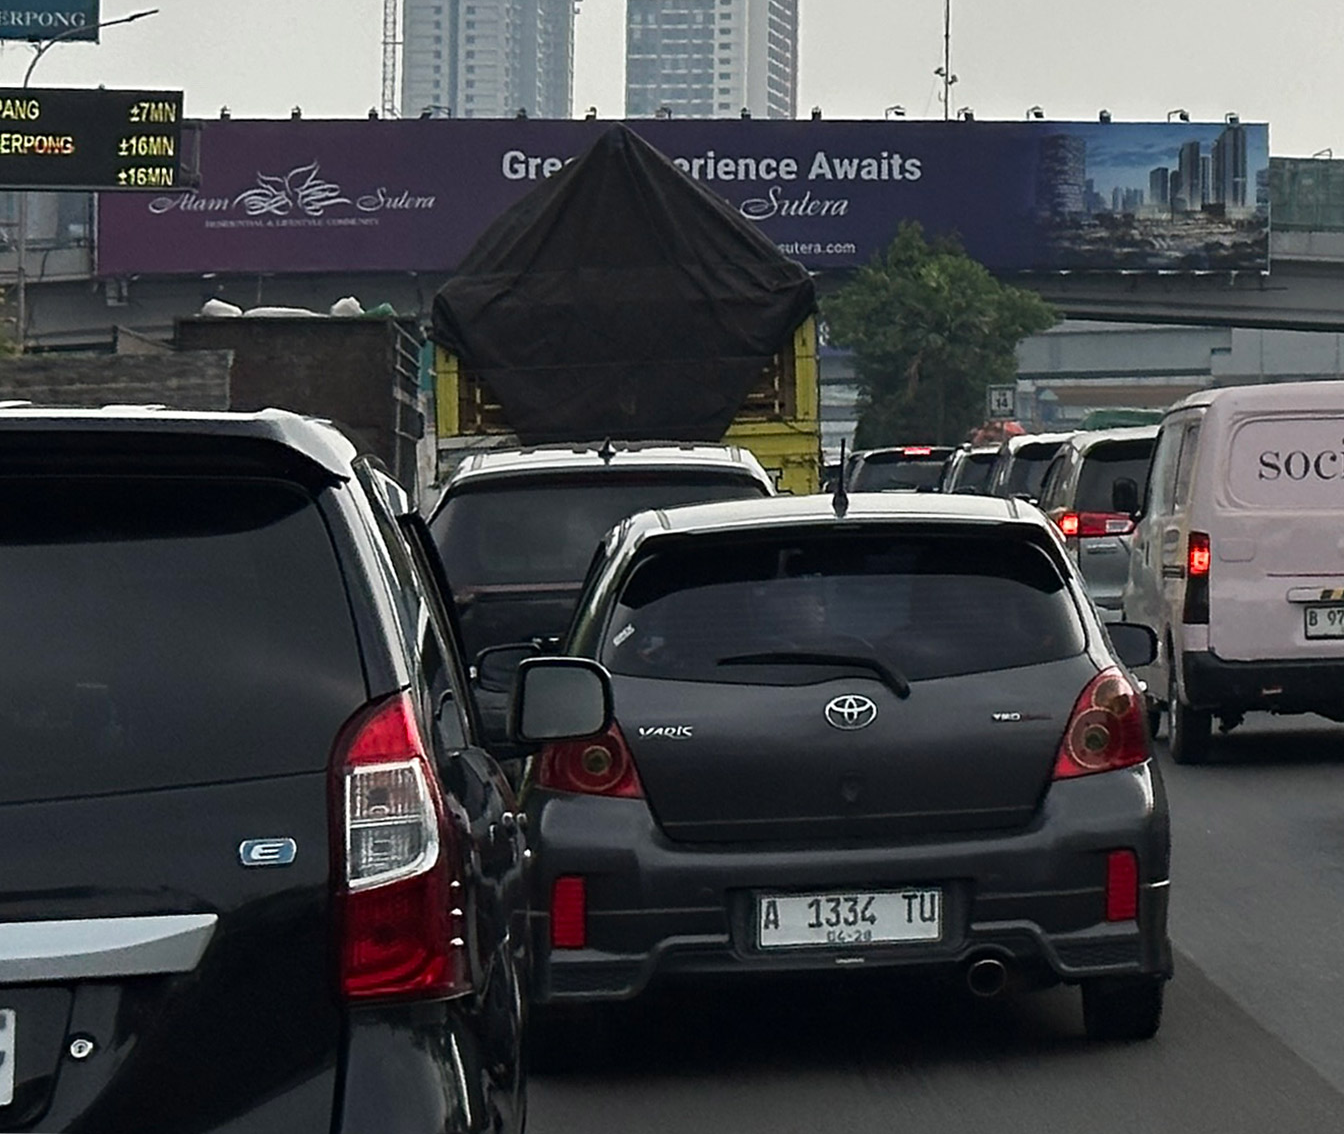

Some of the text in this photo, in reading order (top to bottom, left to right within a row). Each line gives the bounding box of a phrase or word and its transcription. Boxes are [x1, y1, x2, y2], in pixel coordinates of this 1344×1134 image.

[0, 133, 75, 154] ERPONG
[502, 150, 578, 180] Gre
[808, 151, 922, 180] Awaits
[356, 187, 437, 212] Sutera
[739, 185, 850, 221] Sutera
[1308, 610, 1318, 627] B
[763, 893, 936, 930] A 1334 TU
